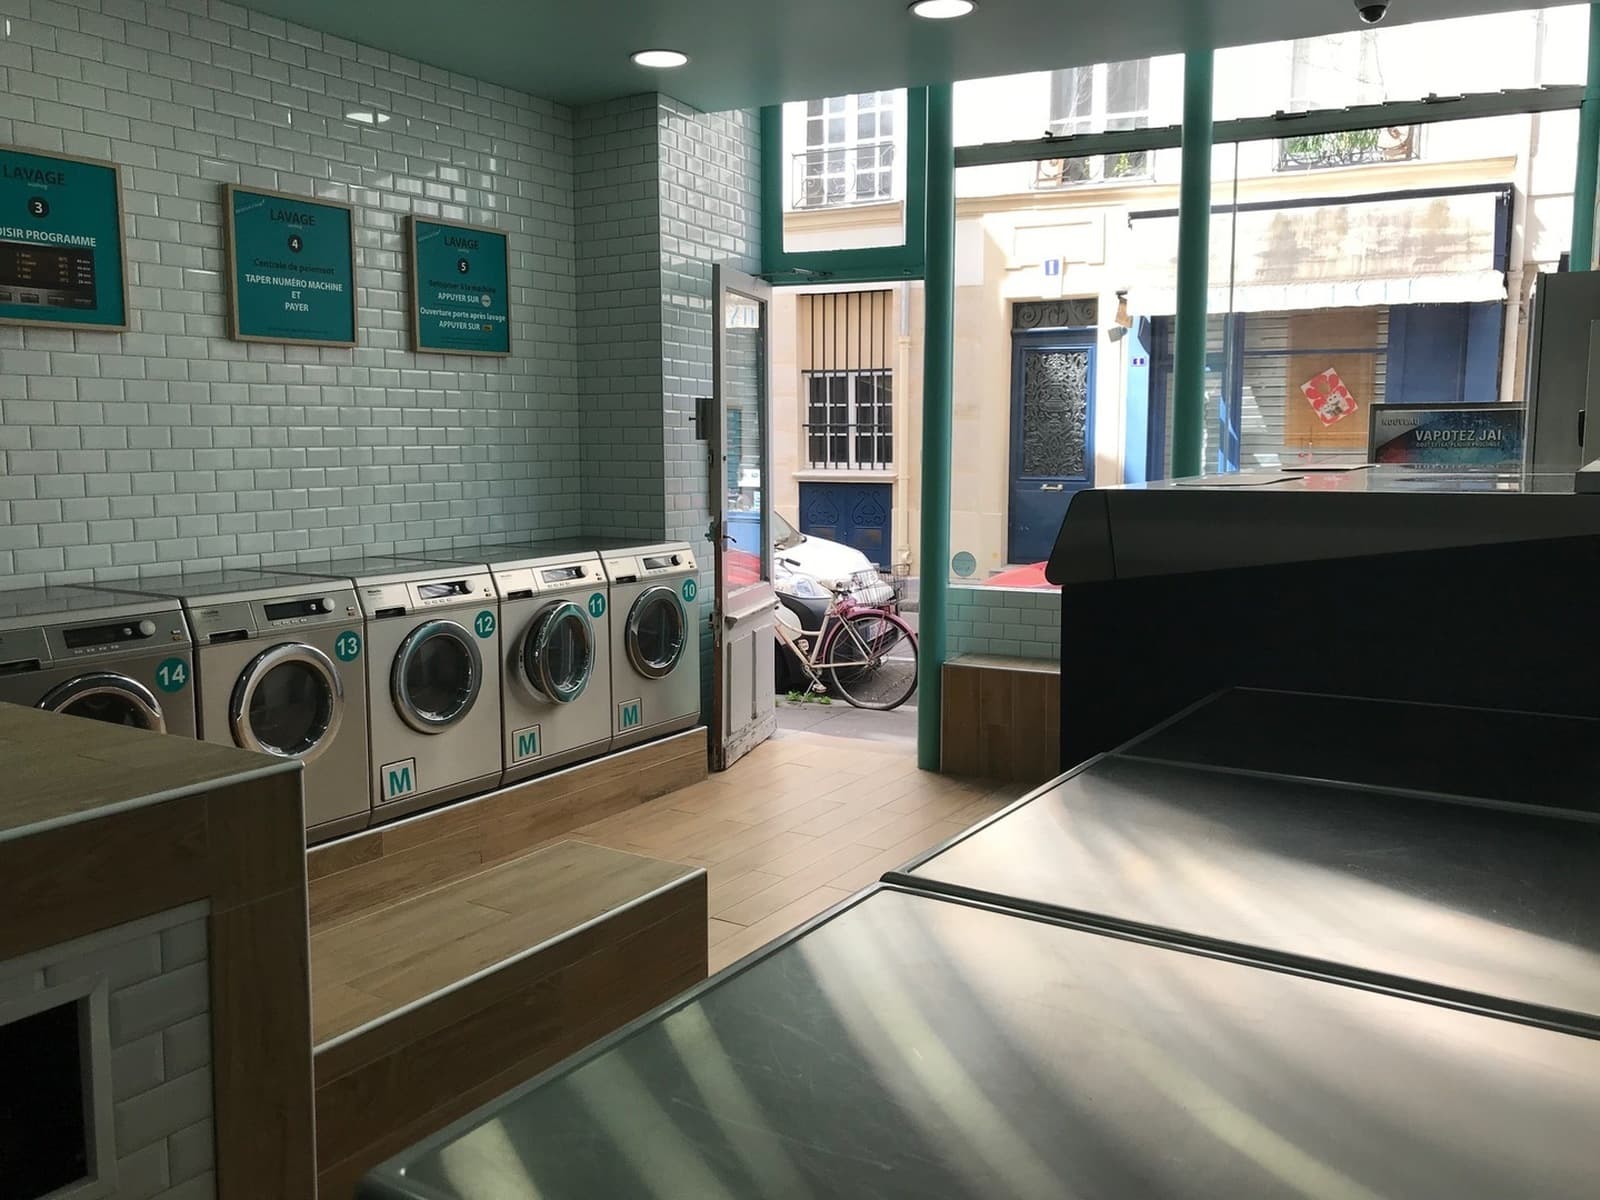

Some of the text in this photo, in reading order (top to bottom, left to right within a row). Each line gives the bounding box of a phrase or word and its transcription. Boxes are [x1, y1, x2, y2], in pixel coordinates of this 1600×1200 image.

[3, 164, 65, 185] LAVAGE
[34, 201, 43, 213] 3
[271, 209, 315, 226] LAVAGE
[26, 229, 97, 248] PROGRAMME
[292, 239, 298, 249] 4
[445, 236, 479, 249] LAVAGE
[461, 262, 467, 271] 5
[245, 274, 343, 292] TAPER NUMÉRO MACHINE
[291, 290, 302, 299] ET
[438, 292, 480, 304] APPUYER SUR
[285, 302, 309, 312] PAYER
[420, 307, 506, 323] Ouverture porte après lavage
[439, 320, 467, 330] APPUYER
[468, 322, 480, 331] SUR
[1415, 430, 1475, 441] VAPOTEZ
[683, 583, 695, 598] 10
[590, 598, 603, 614] 11
[476, 616, 494, 634] 12
[337, 637, 358, 656] 13
[159, 664, 186, 686] 14
[623, 705, 638, 728] M
[518, 732, 537, 757] M
[389, 766, 412, 797] M
